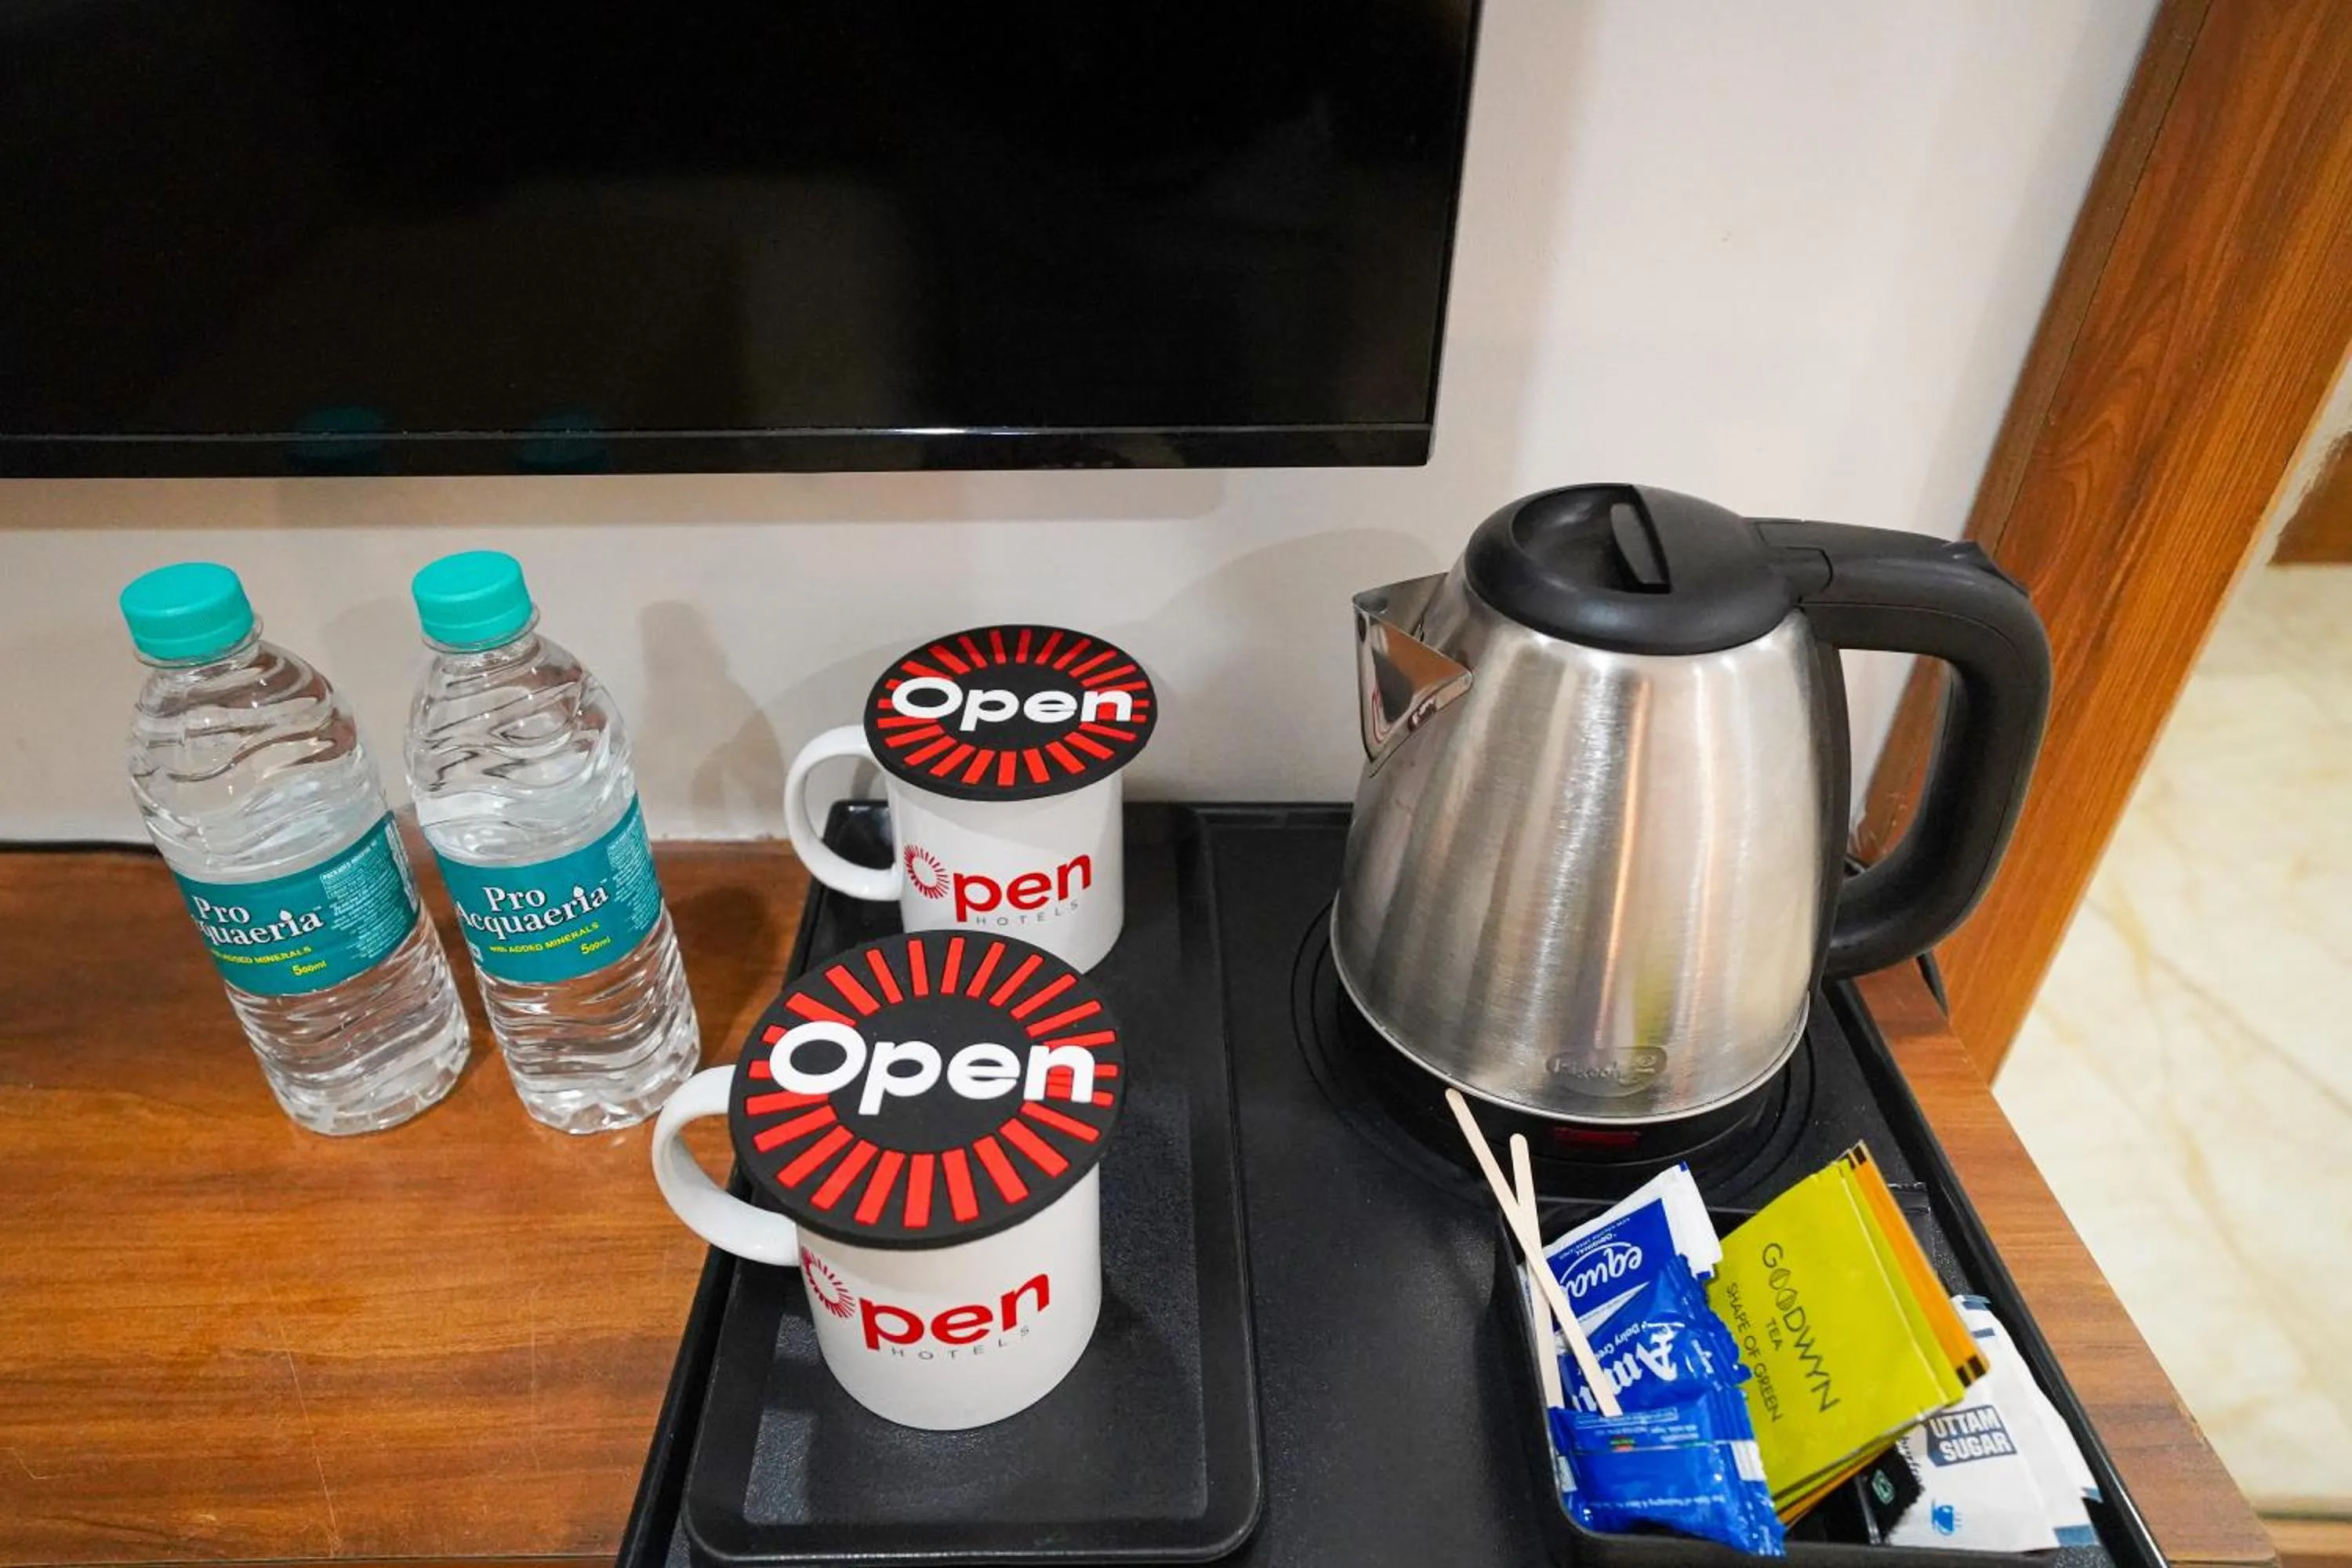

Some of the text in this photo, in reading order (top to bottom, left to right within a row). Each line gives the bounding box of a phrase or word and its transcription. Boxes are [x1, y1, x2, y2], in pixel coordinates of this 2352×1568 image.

[891, 676, 1134, 732] Open
[191, 895, 251, 924] Pro
[454, 884, 610, 942] Acquaeria
[481, 886, 546, 913] Pro
[975, 902, 1079, 927] HOTELS
[509, 944, 543, 953] ADDED
[545, 921, 600, 949] MINERALS
[768, 1020, 1096, 1116] Open
[1563, 1245, 1643, 1298] equa
[891, 1325, 1030, 1361] HOTELS
[1614, 1322, 1641, 1346] Dairy
[1762, 1242, 1842, 1414] GOODWYN
[1766, 1316, 1784, 1352] TEA
[1572, 1324, 1679, 1413] Am
[1726, 1281, 1784, 1423] SHAPE OF GREEN
[1929, 1406, 2003, 1439] UTTAM
[1939, 1430, 2013, 1463] SUGAR
